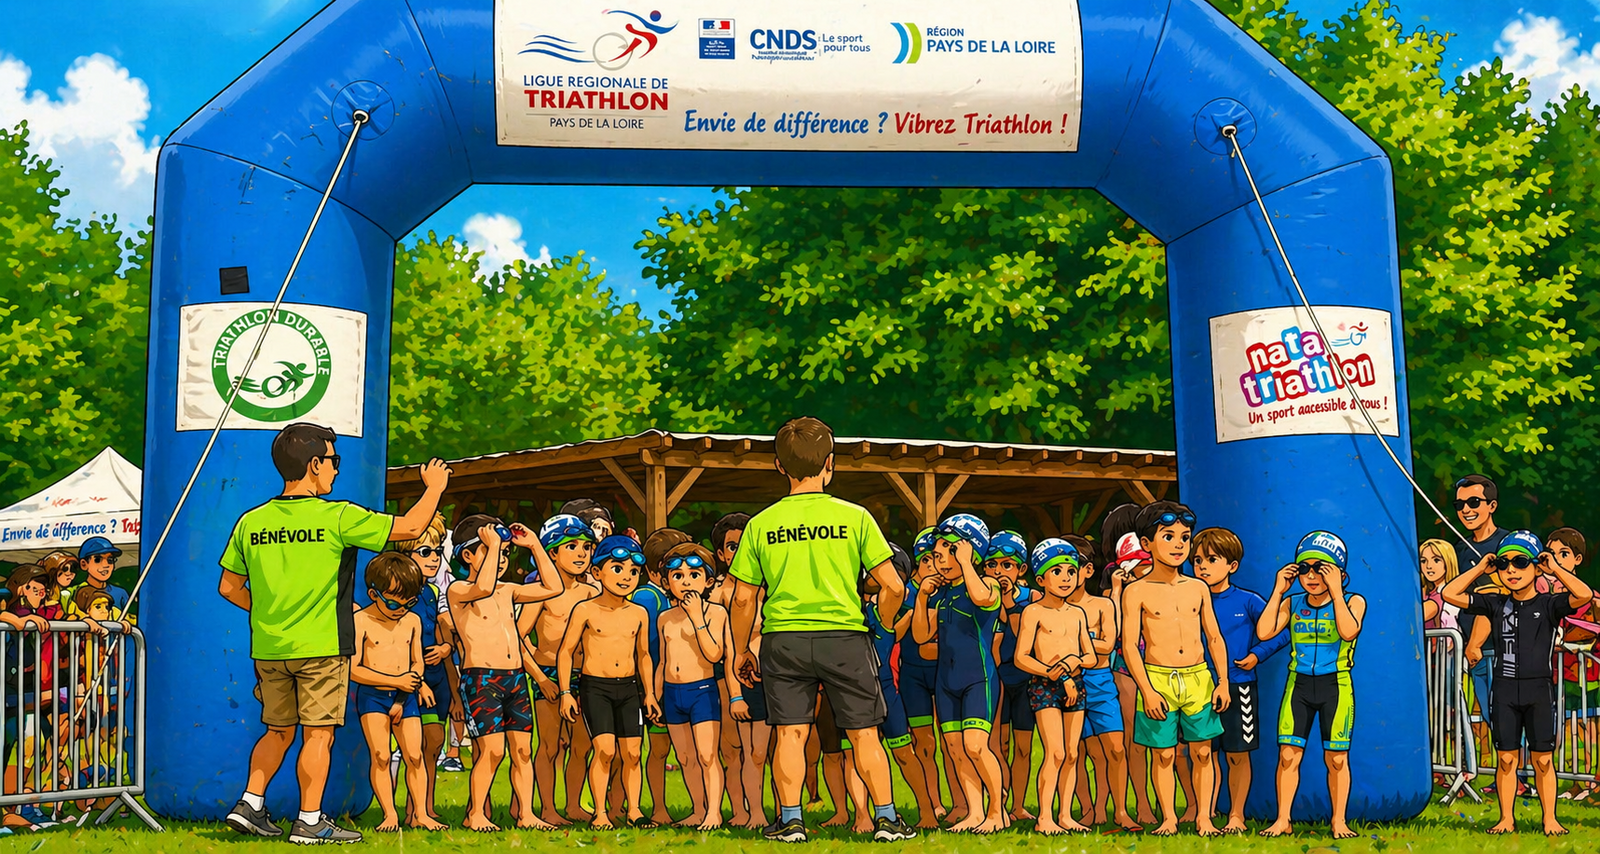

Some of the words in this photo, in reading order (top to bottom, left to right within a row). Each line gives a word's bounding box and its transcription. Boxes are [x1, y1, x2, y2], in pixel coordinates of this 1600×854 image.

[749, 28, 817, 51] CNDS
[822, 34, 835, 43] Le
[837, 35, 864, 46] sport
[926, 26, 965, 37] RÉGION
[823, 45, 846, 54] pour
[848, 44, 871, 52] tous
[926, 39, 964, 53] PAYS
[967, 39, 988, 53] DE
[991, 40, 1011, 53] LA
[1014, 40, 1056, 54] LOIRE
[523, 75, 563, 88] LIGUE
[567, 76, 647, 90] REGIONALE
[651, 78, 669, 90] DE
[524, 90, 669, 111] TRIATHLON
[549, 117, 576, 129] PAYS
[579, 118, 593, 129] DE
[596, 118, 611, 129] LA
[613, 118, 644, 130] LOIRE
[684, 109, 736, 133] Envie
[743, 111, 767, 133] de
[773, 111, 869, 138] différence
[878, 111, 889, 134] ?
[894, 111, 957, 135] Vibrez
[963, 112, 1053, 135] Triathlon
[1059, 112, 1069, 135] !
[285, 313, 330, 375] DURABLE
[1248, 328, 1324, 374] nata
[1242, 354, 1375, 407] triathlon
[1248, 411, 1264, 424] Un
[1267, 405, 1295, 424] sport
[2, 527, 32, 543] Envie
[249, 526, 326, 546] BÉNÉVOLE
